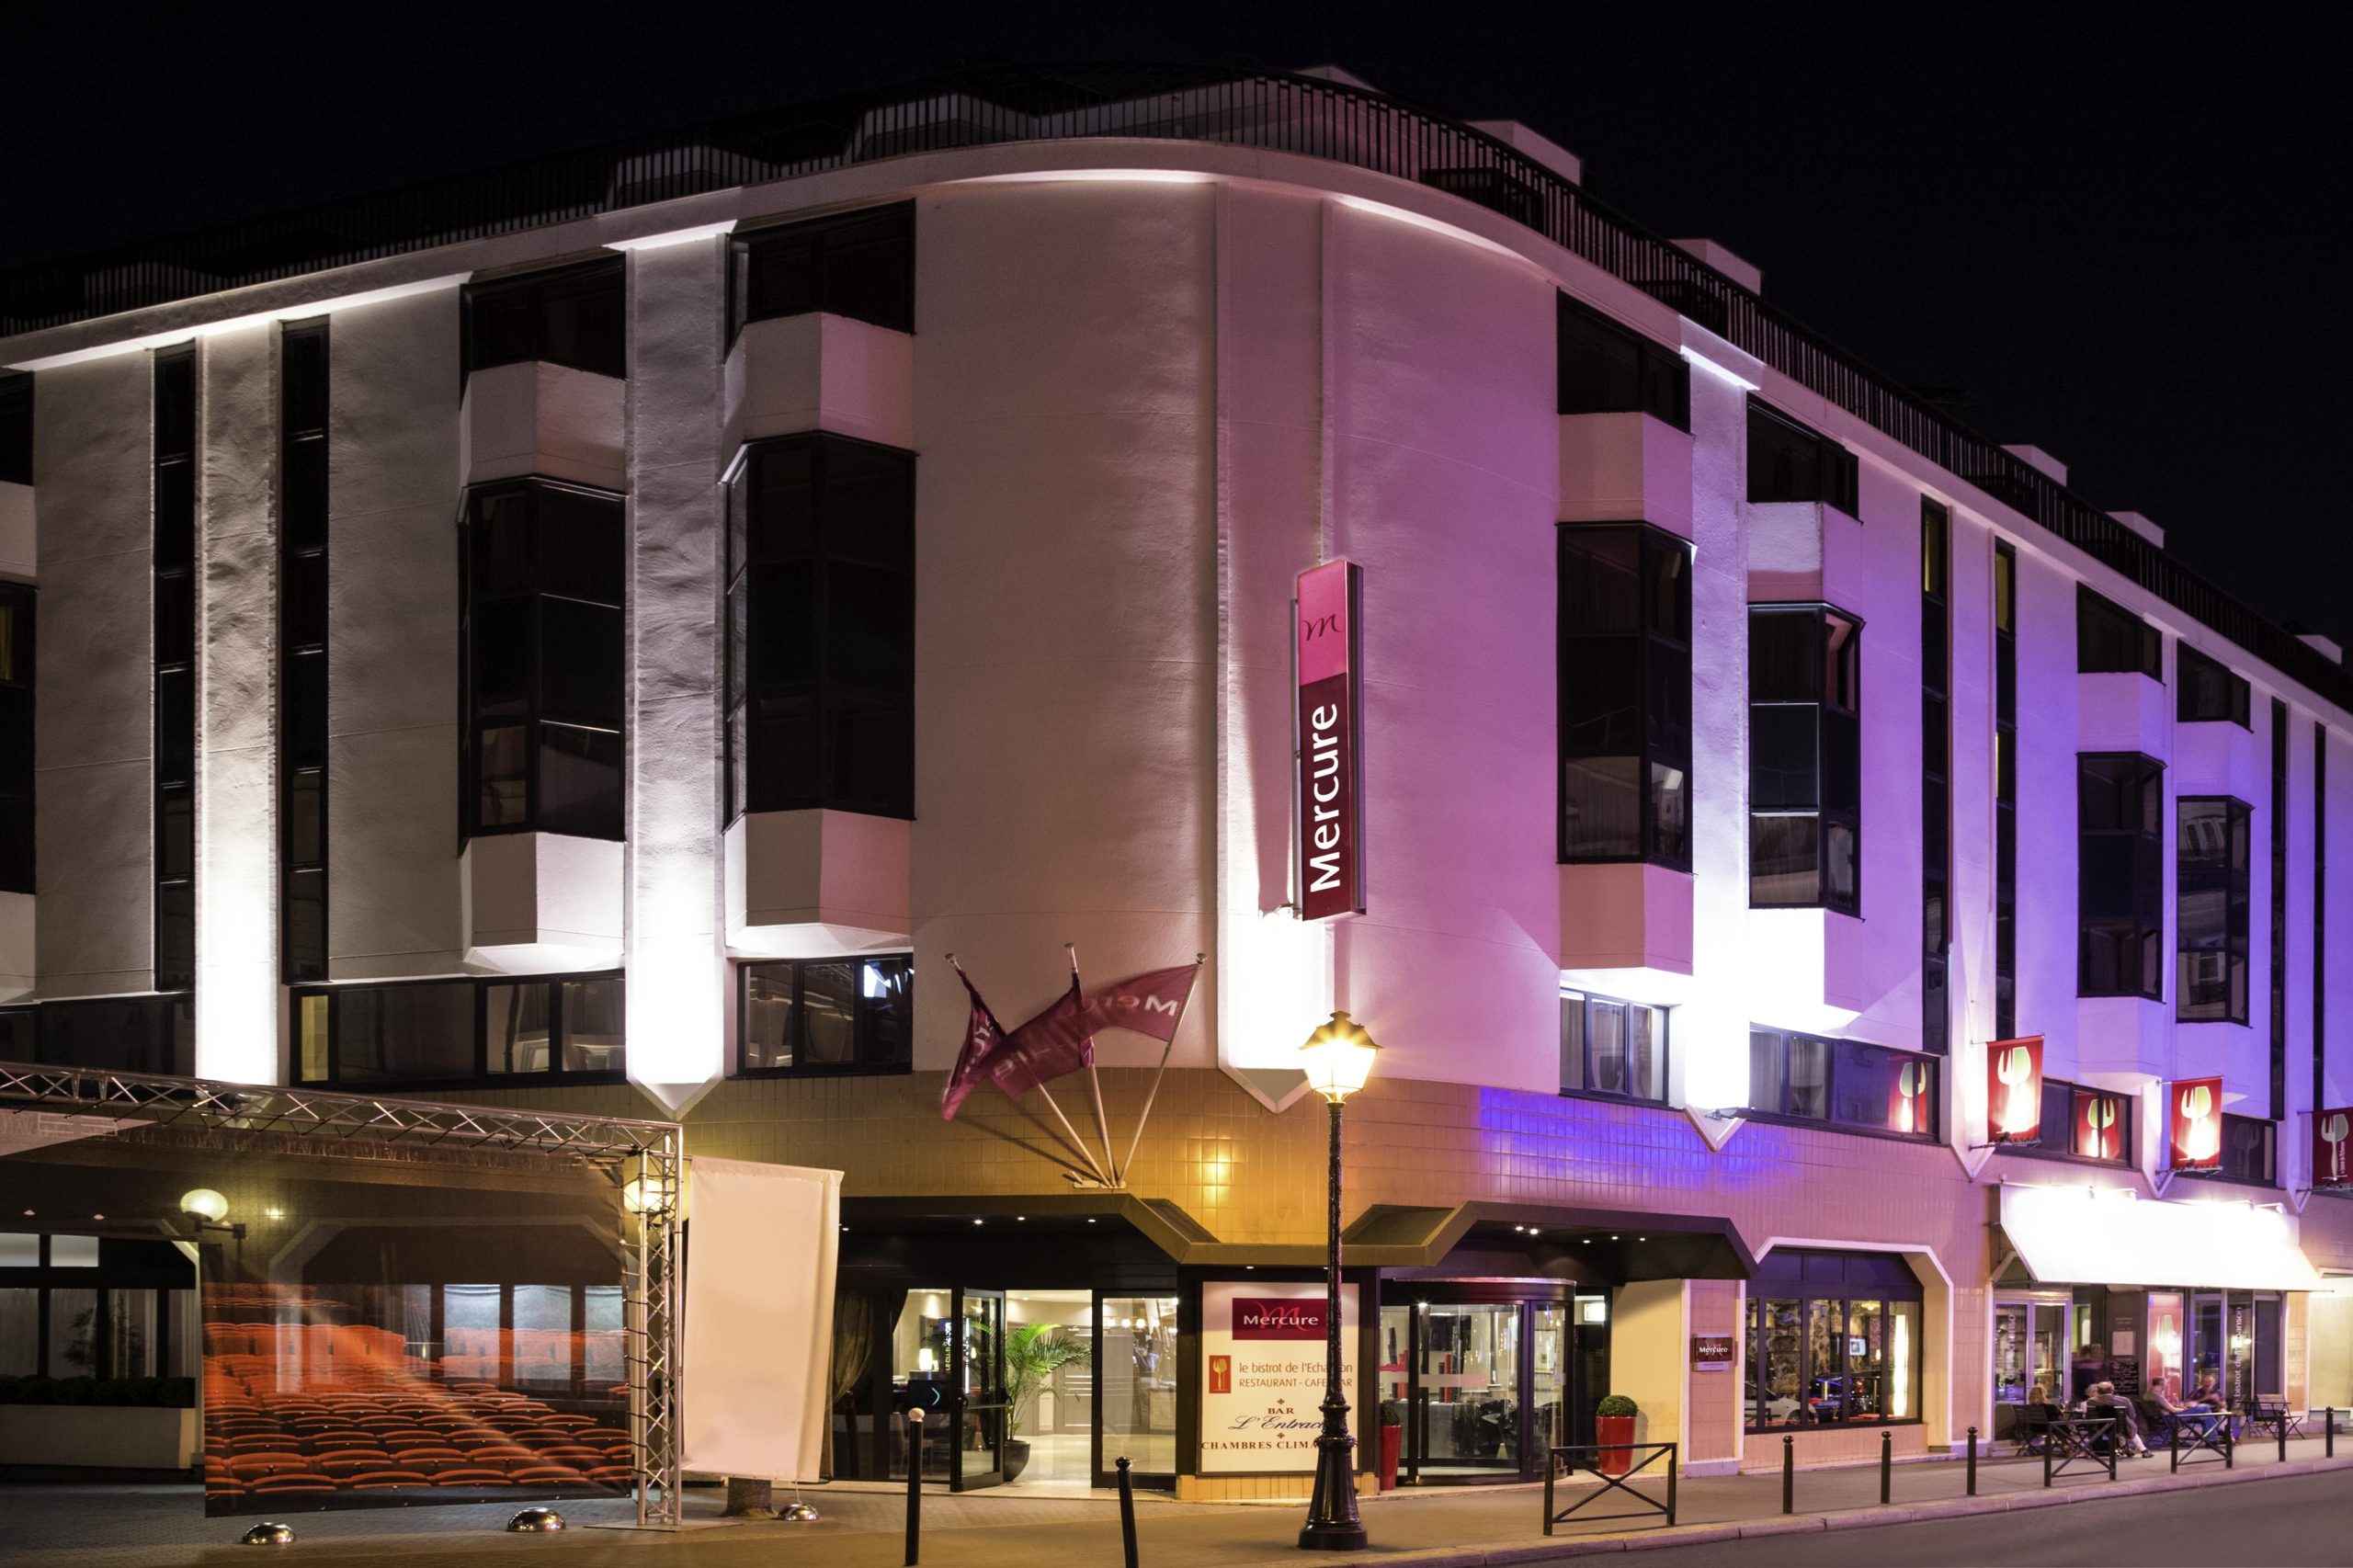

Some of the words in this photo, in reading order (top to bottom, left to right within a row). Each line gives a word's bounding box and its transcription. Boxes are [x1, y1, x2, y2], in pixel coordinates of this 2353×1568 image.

[1309, 702, 1341, 892] Mercure
[1244, 1314, 1319, 1325] Mercure
[1239, 1362, 1248, 1373] le
[1252, 1362, 1282, 1373] bistrot
[1285, 1362, 1299, 1373] de
[1302, 1362, 1353, 1373] l'Echaon
[1239, 1379, 1297, 1387] RESTAURANT
[1228, 1415, 1324, 1430] L'Entrac
[1201, 1441, 1272, 1449] CHAMBRES
